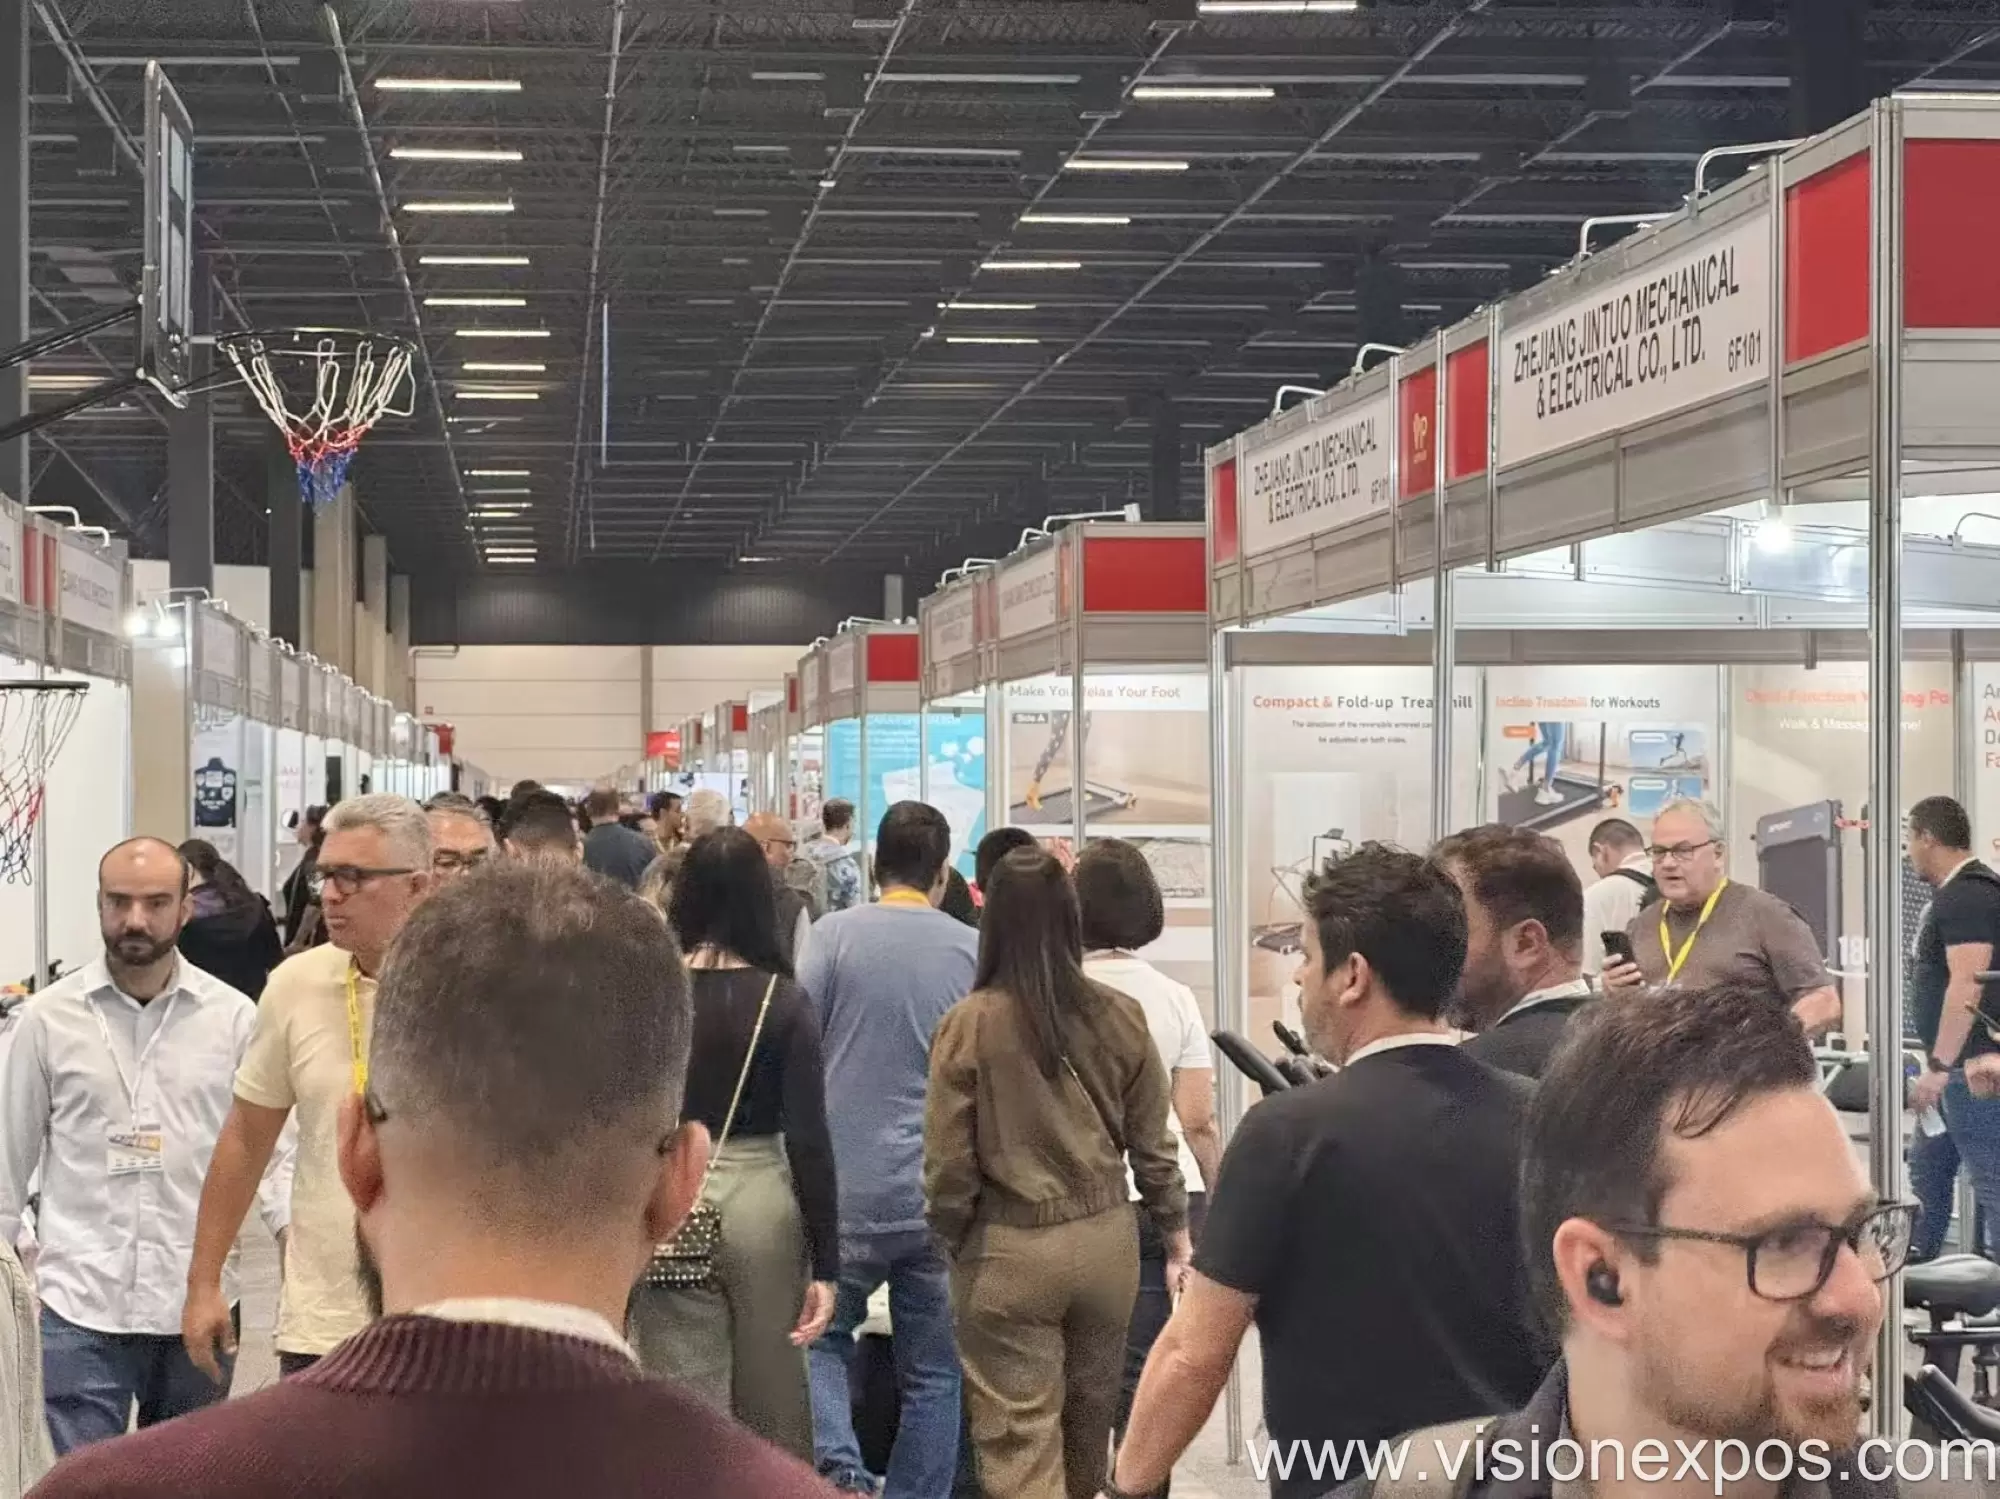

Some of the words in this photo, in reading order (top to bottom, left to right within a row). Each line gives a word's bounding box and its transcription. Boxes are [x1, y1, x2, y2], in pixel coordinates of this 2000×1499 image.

[1514, 318, 1576, 383] ZHEJIANG
[1580, 293, 1632, 358] JINTUO
[1635, 246, 1739, 336] MECHANICAL
[1727, 329, 1761, 373] 6F101
[1537, 377, 1545, 419] &
[1549, 344, 1633, 415] ELECTRICAL
[1637, 331, 1667, 383] CO.,
[1672, 315, 1705, 372] LTD.
[1009, 685, 1045, 698] Make
[1117, 686, 1148, 698] Your
[1151, 686, 1181, 698] Foot
[1253, 695, 1319, 710] Compact
[1322, 695, 1333, 709] &
[1337, 695, 1394, 711] Fold-up
[1590, 696, 1605, 708] for
[1608, 696, 1661, 709] Workouts
